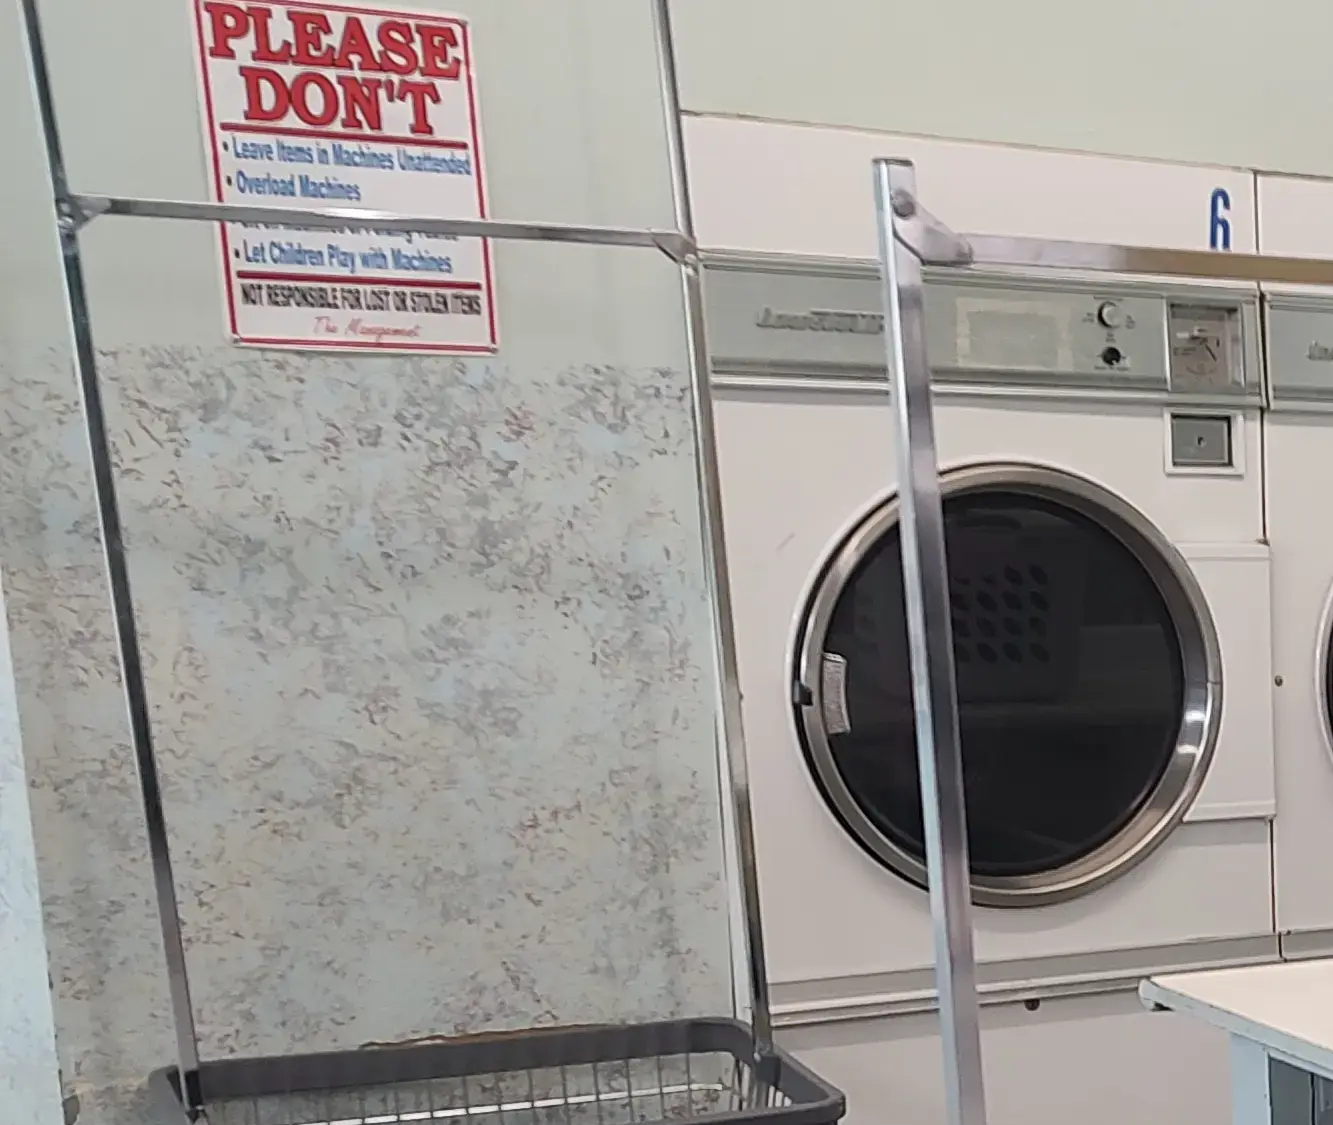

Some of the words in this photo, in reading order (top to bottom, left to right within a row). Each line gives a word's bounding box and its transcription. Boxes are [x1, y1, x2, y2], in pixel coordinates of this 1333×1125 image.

[205, 2, 462, 81] PLEASE
[239, 66, 441, 135] DON'T
[231, 135, 274, 161] Leave
[276, 139, 314, 164] Items
[315, 141, 329, 165] in
[331, 143, 394, 170] Machines
[397, 147, 472, 175] Unattended
[236, 169, 296, 197] Overload
[298, 174, 361, 201] Machines
[1209, 187, 1231, 252] 6
[243, 239, 267, 263] Let
[269, 241, 325, 267] Children
[327, 243, 356, 274] Play
[359, 247, 388, 270] with
[391, 247, 453, 275] Machines
[240, 283, 264, 307] NOT
[266, 284, 341, 310] RESPONSIBLE
[341, 287, 362, 310] FOR
[364, 288, 390, 311] LOST
[392, 290, 408, 312] OR
[410, 290, 449, 314] STOLEN
[451, 292, 482, 316] ITEMS
[313, 315, 338, 334] The
[344, 317, 421, 341] Management
